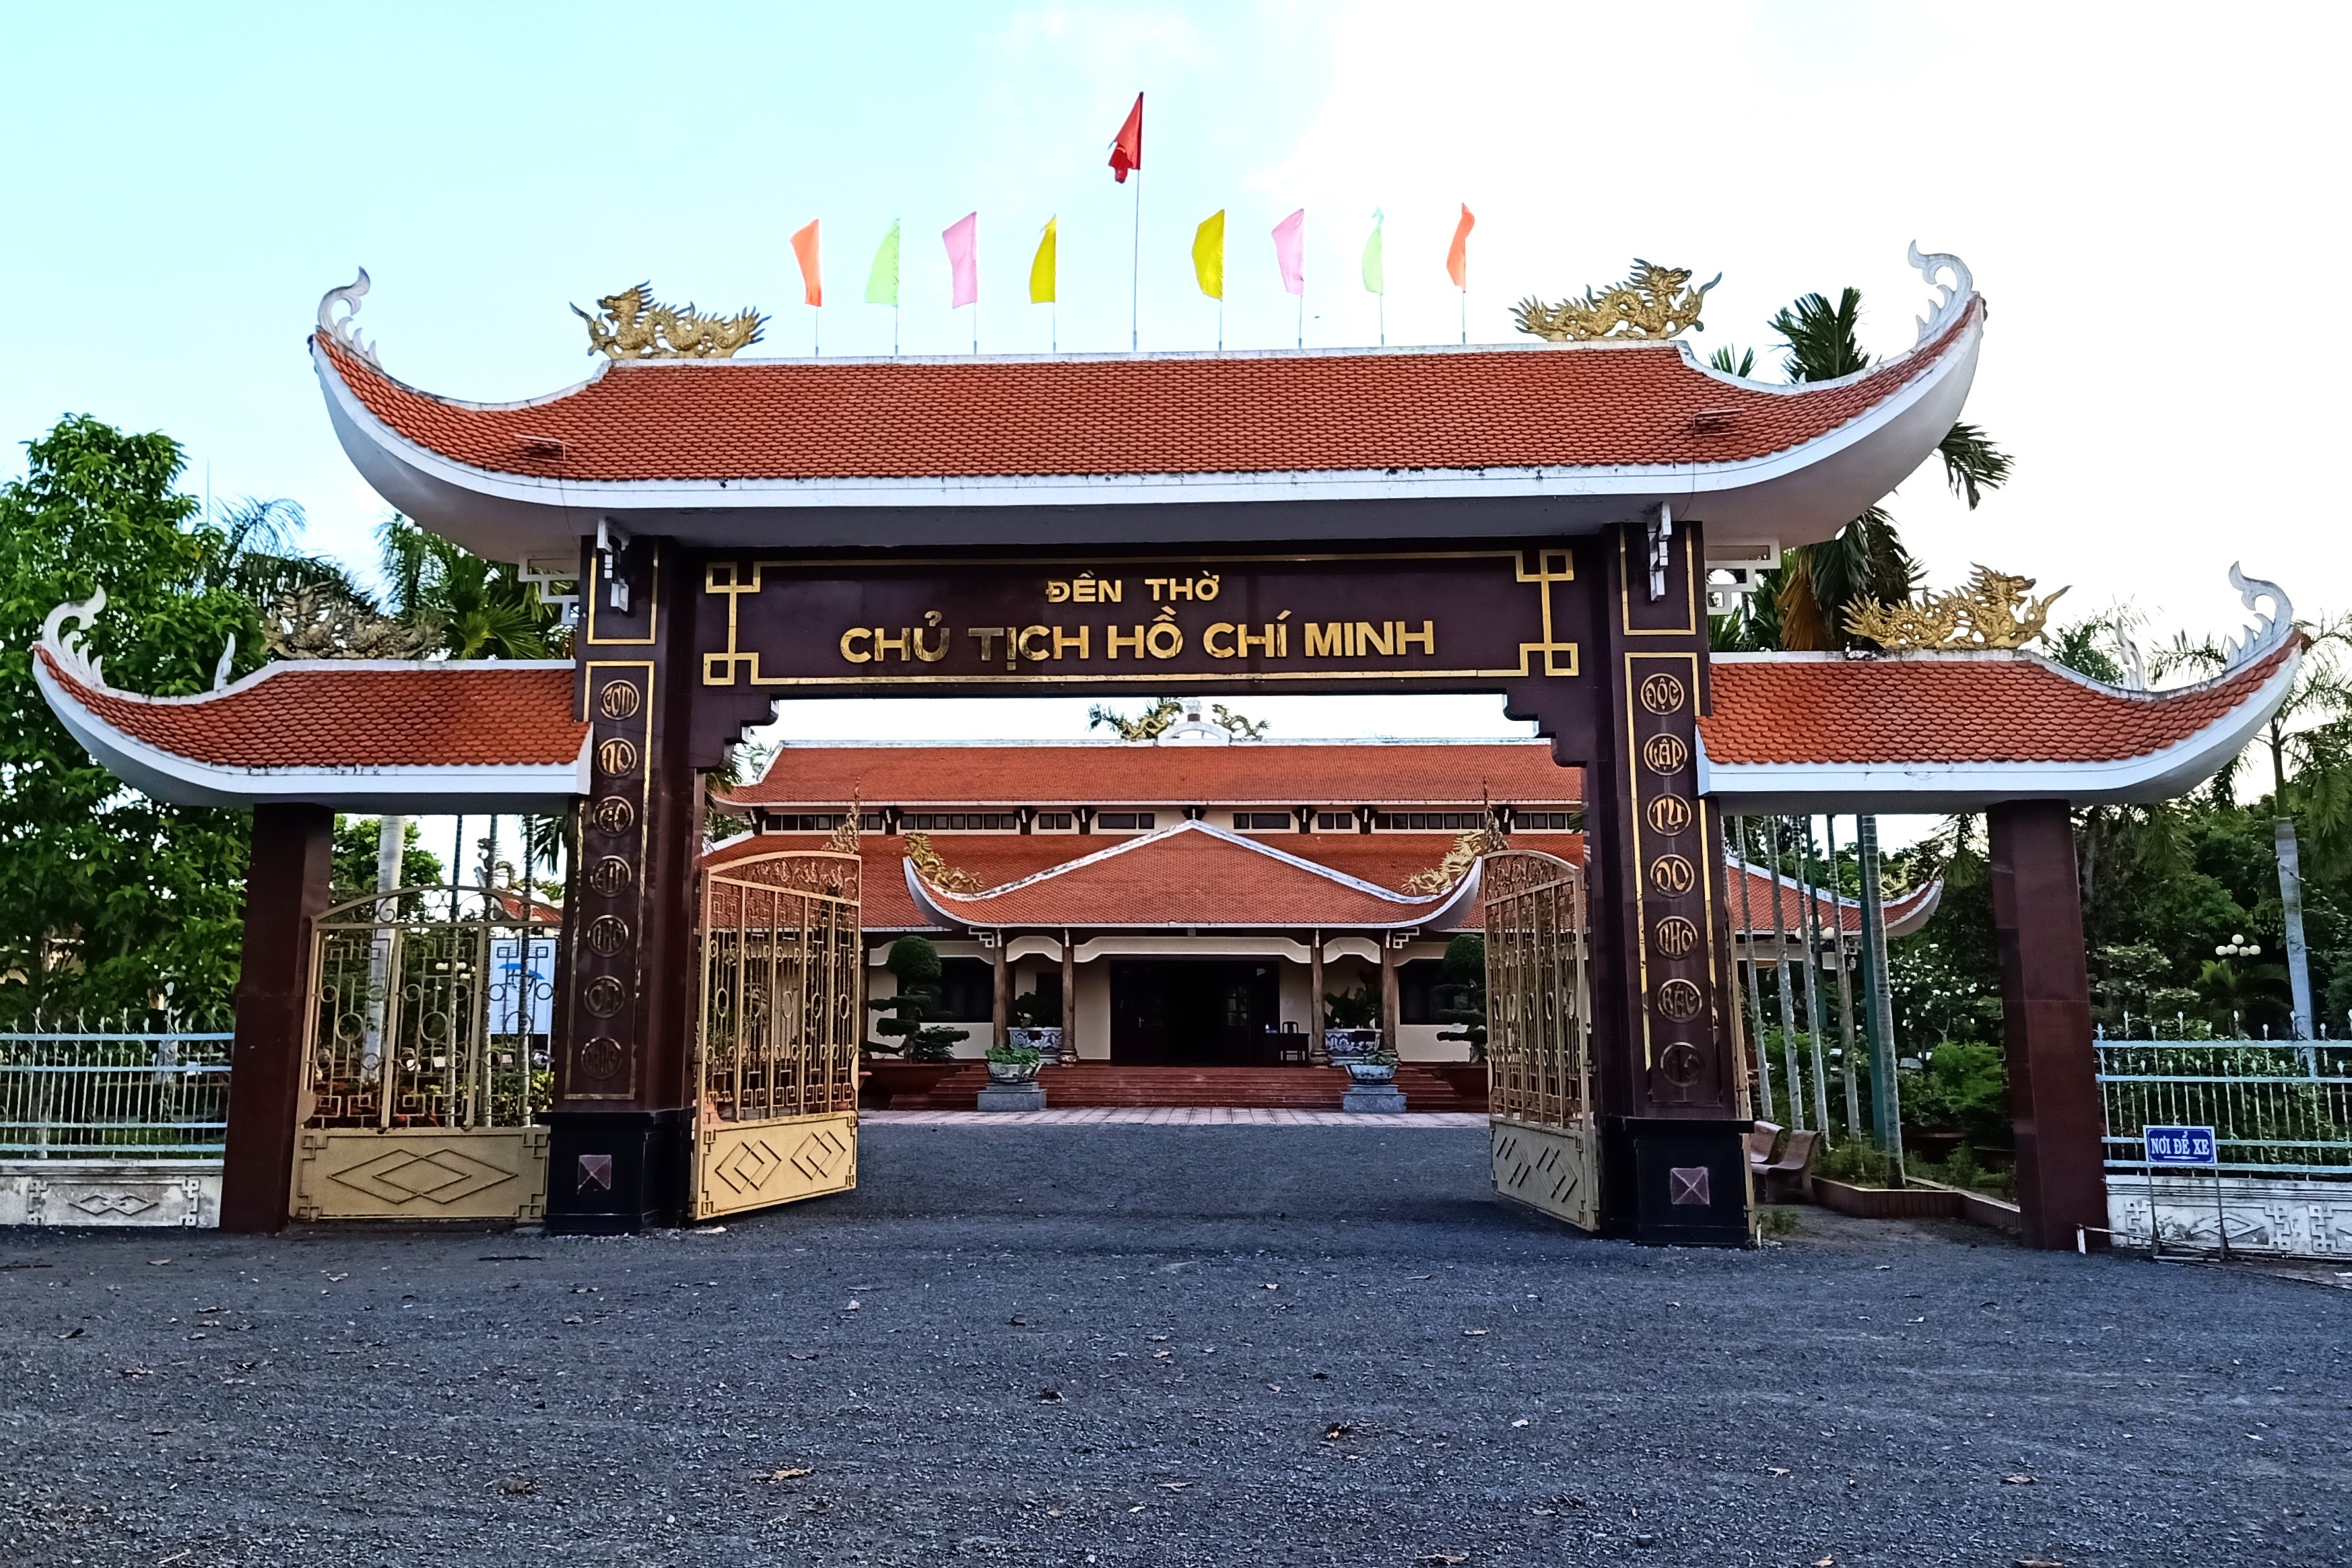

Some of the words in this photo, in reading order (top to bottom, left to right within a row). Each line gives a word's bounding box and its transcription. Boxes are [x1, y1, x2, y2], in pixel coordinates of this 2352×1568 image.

[1045, 570, 1122, 603] ĐỀN
[1144, 570, 1220, 601] THỜ
[840, 610, 950, 663] CHỦ
[968, 625, 1089, 671] TỊCH
[1107, 605, 1184, 659] HỒ
[1203, 609, 1292, 658] CHÍ
[1304, 620, 1435, 657] MINH
[1644, 677, 1679, 711] ĐỘC
[1648, 737, 1683, 772] LẬP
[1652, 798, 1686, 831] TỰ
[1655, 858, 1689, 891] DO
[1658, 920, 1693, 956] NHỚ
[1661, 982, 1698, 1018] BÁC
[2150, 1134, 2172, 1155] NƠI
[2172, 1130, 2190, 1155] ĐỂ
[2192, 1138, 2210, 1155] XE
